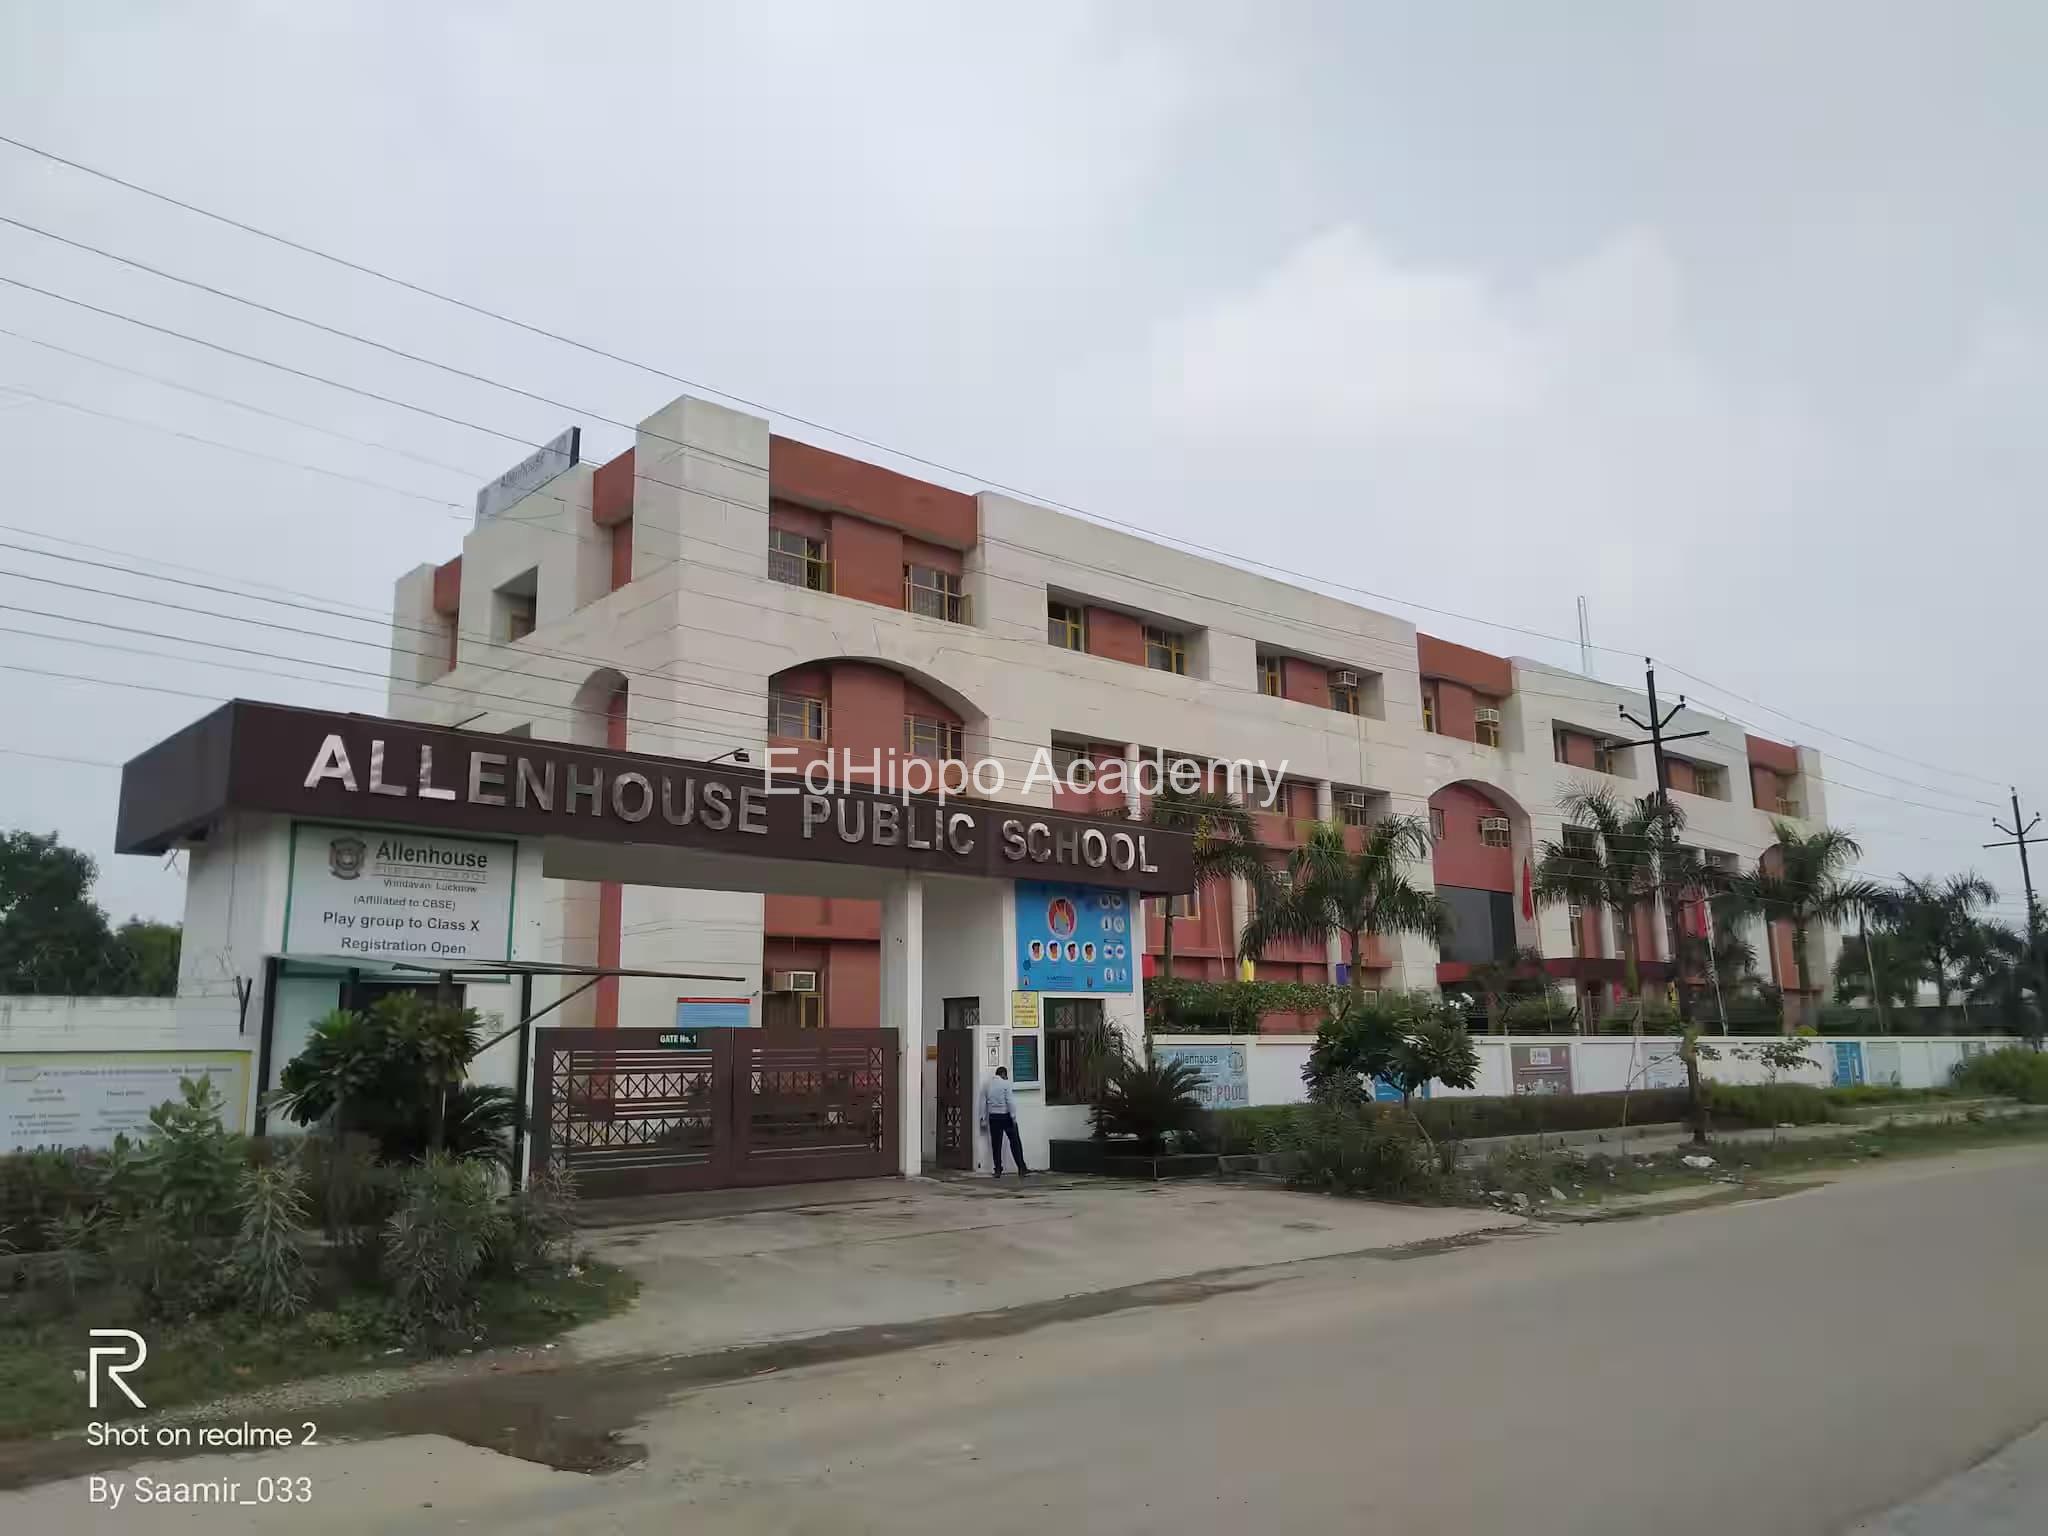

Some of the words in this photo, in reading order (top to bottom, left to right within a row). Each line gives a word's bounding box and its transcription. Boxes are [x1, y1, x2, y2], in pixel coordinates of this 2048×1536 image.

[303, 733, 769, 835] ALLENHOUSE
[803, 795, 976, 855] PUBLIC
[1002, 820, 1159, 873] SCHOOL
[376, 840, 488, 868] Allenhouse
[409, 898, 419, 908] to
[323, 911, 356, 927] Play
[360, 915, 405, 930] group
[409, 917, 423, 929] to
[427, 917, 466, 931] Class
[470, 919, 481, 932] X
[341, 936, 427, 953] Registration
[431, 941, 467, 955] Open
[660, 1034, 679, 1044] GATE
